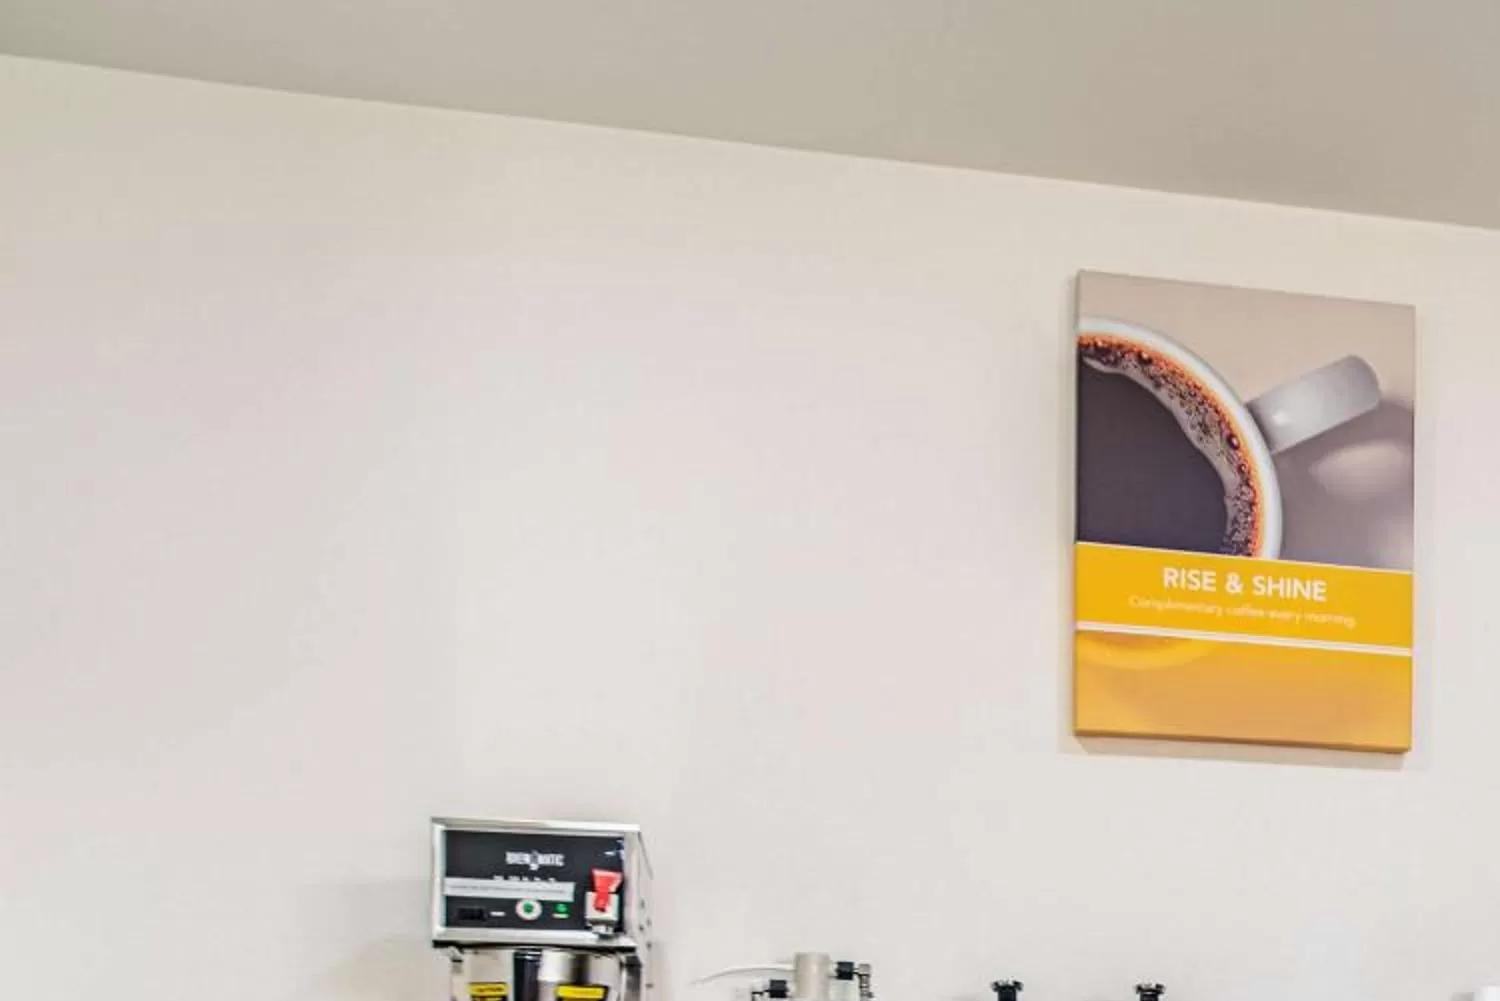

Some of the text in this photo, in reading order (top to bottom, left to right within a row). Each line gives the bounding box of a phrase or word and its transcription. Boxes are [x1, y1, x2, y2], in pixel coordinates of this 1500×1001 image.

[1163, 567, 1327, 602] RISE & SHINE
[1128, 595, 1222, 616] Complimentary
[1226, 603, 1264, 619] coffee
[1269, 609, 1301, 624] every
